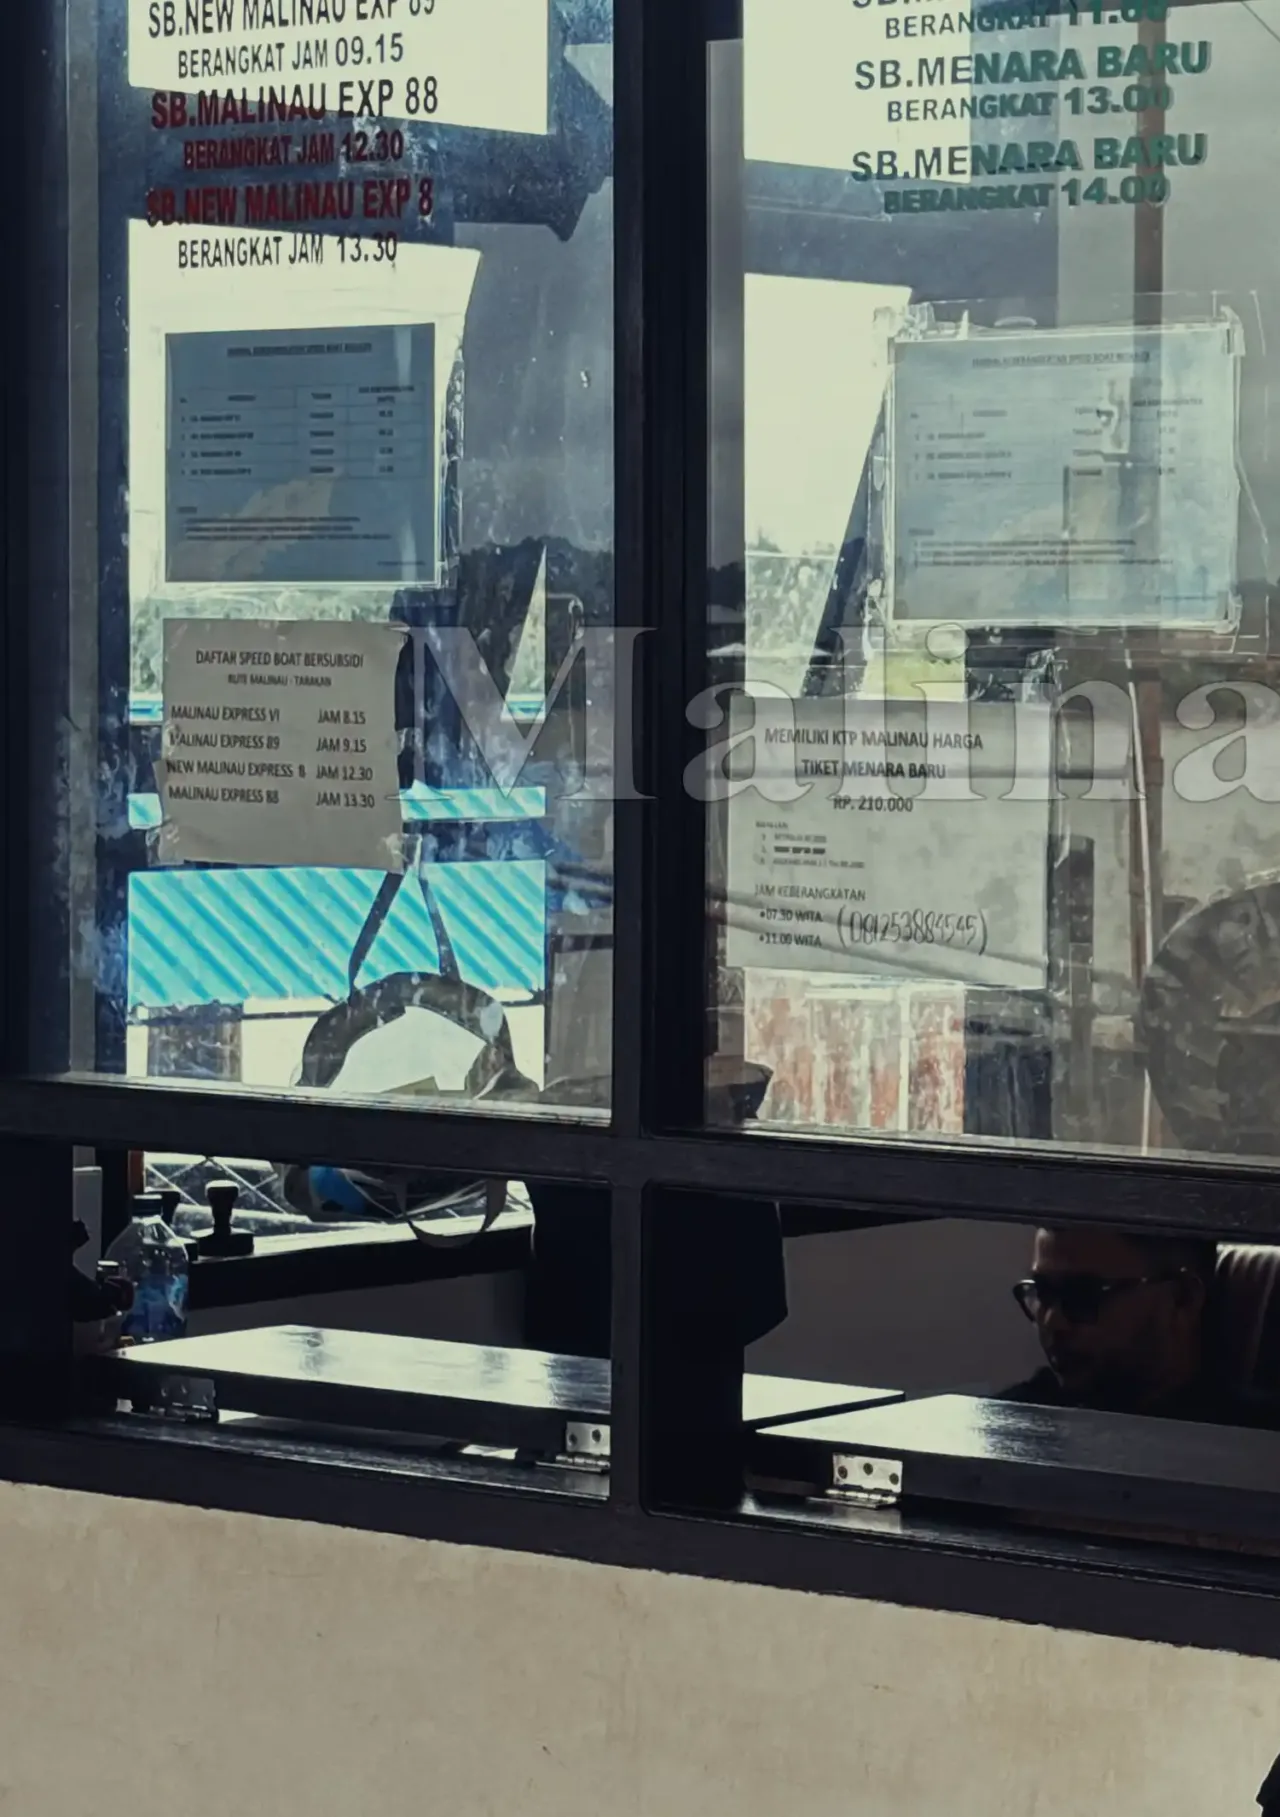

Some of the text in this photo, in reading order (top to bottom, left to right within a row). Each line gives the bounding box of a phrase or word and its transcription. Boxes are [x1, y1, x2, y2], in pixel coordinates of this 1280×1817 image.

[148, 0, 233, 38] SB.NEW
[886, 6, 1050, 39] BERANGKAT
[178, 33, 404, 78] BERANGKAT JAM 09.15
[855, 41, 1212, 90] SB.MENARA BARU
[151, 75, 439, 129] SB.MALINAU EXP 88
[887, 84, 1174, 122] BERANGKAT 13.00
[183, 129, 405, 171] BERANGKAT JAM 12.30
[853, 133, 1208, 182] SB.MENARA BARU
[147, 183, 236, 227] SB.NEW
[245, 180, 354, 222] MALINAU
[363, 175, 411, 219] EXP
[884, 176, 1171, 213] BERANGKAT 14.00
[178, 232, 398, 269] BERANGKAT JAM 13.30
[196, 650, 364, 669] DAFTAR SPEED BOAT BERSUBSIDI
[170, 705, 220, 721] MALINAU
[221, 706, 267, 722] EXPRESS
[317, 709, 341, 724] JAM
[342, 710, 367, 725] 8.15
[220, 733, 265, 749] EXPRESS
[265, 735, 281, 750] 89
[316, 737, 341, 752] JAM
[342, 738, 368, 753] 9.15
[764, 727, 984, 750] MEMILIKI KTP MALINAU HARGA
[166, 760, 194, 774] NEW
[197, 761, 246, 776] MALINAU
[247, 762, 294, 778] EXPRESS
[315, 765, 340, 779] JAM
[341, 766, 374, 781] 12.30
[801, 759, 947, 780] TIKET MENARA BARU
[168, 786, 219, 801] MALINAU
[220, 787, 264, 803] EXPRESS
[315, 792, 341, 807] JAM
[343, 793, 376, 809] 13.30
[858, 796, 914, 812] 210.000
[776, 885, 867, 902] KEBERANGKATAN
[795, 908, 825, 923] WITA
[795, 934, 823, 949] WITA
